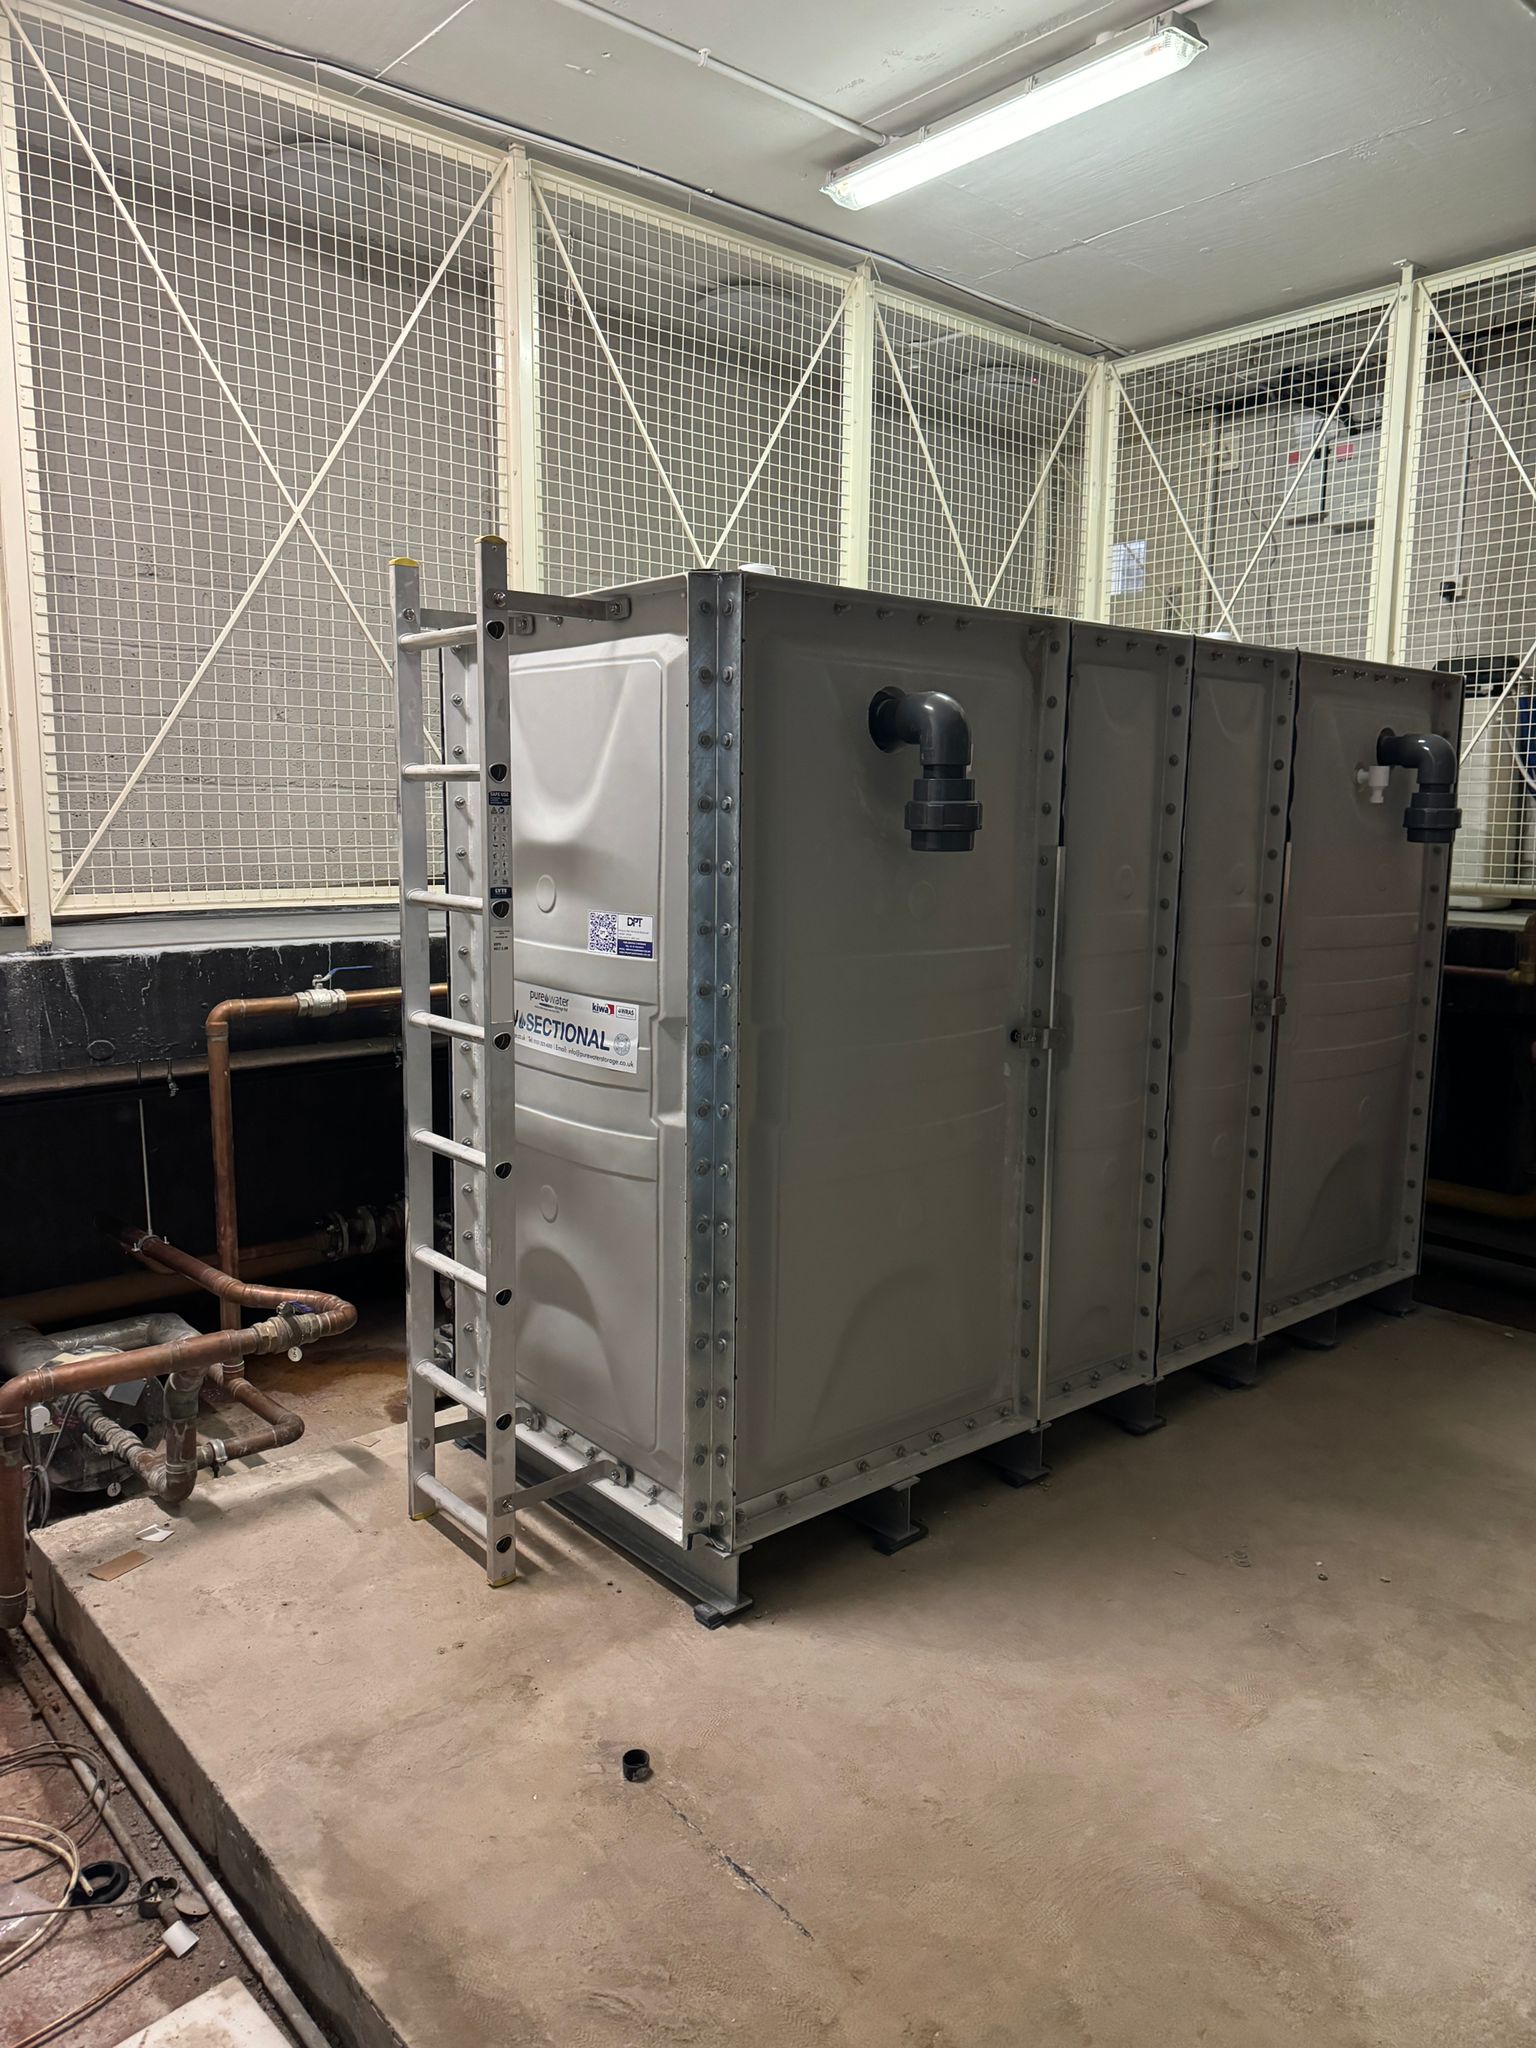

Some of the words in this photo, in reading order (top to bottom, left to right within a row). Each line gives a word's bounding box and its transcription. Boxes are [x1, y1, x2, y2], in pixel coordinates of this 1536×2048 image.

[627, 917, 643, 927] DPT
[592, 1002, 609, 1014] kiwa
[526, 1012, 610, 1051] SECTIONAL
[568, 1048, 634, 1068] info@purewaterstorage.co.uk
